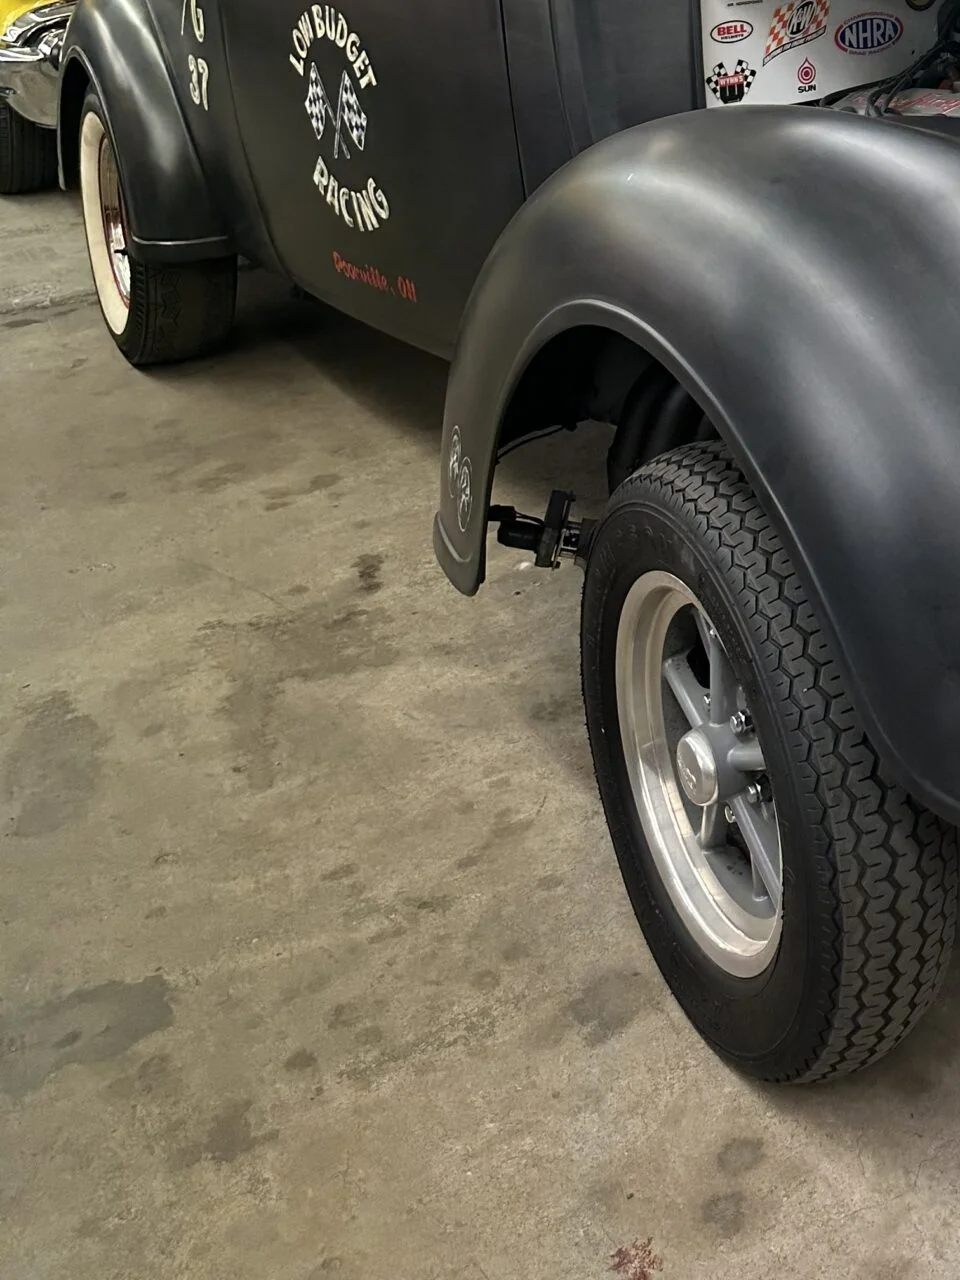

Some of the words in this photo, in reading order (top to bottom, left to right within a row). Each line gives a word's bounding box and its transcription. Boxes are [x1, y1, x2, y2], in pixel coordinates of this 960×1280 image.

[289, 11, 315, 76] LOW
[311, 4, 378, 89] BUDGET
[717, 24, 747, 36] BELL
[845, 18, 895, 49] NHRA
[188, 54, 210, 111] 37
[798, 84, 817, 93] SUN
[313, 155, 390, 232] RACING
